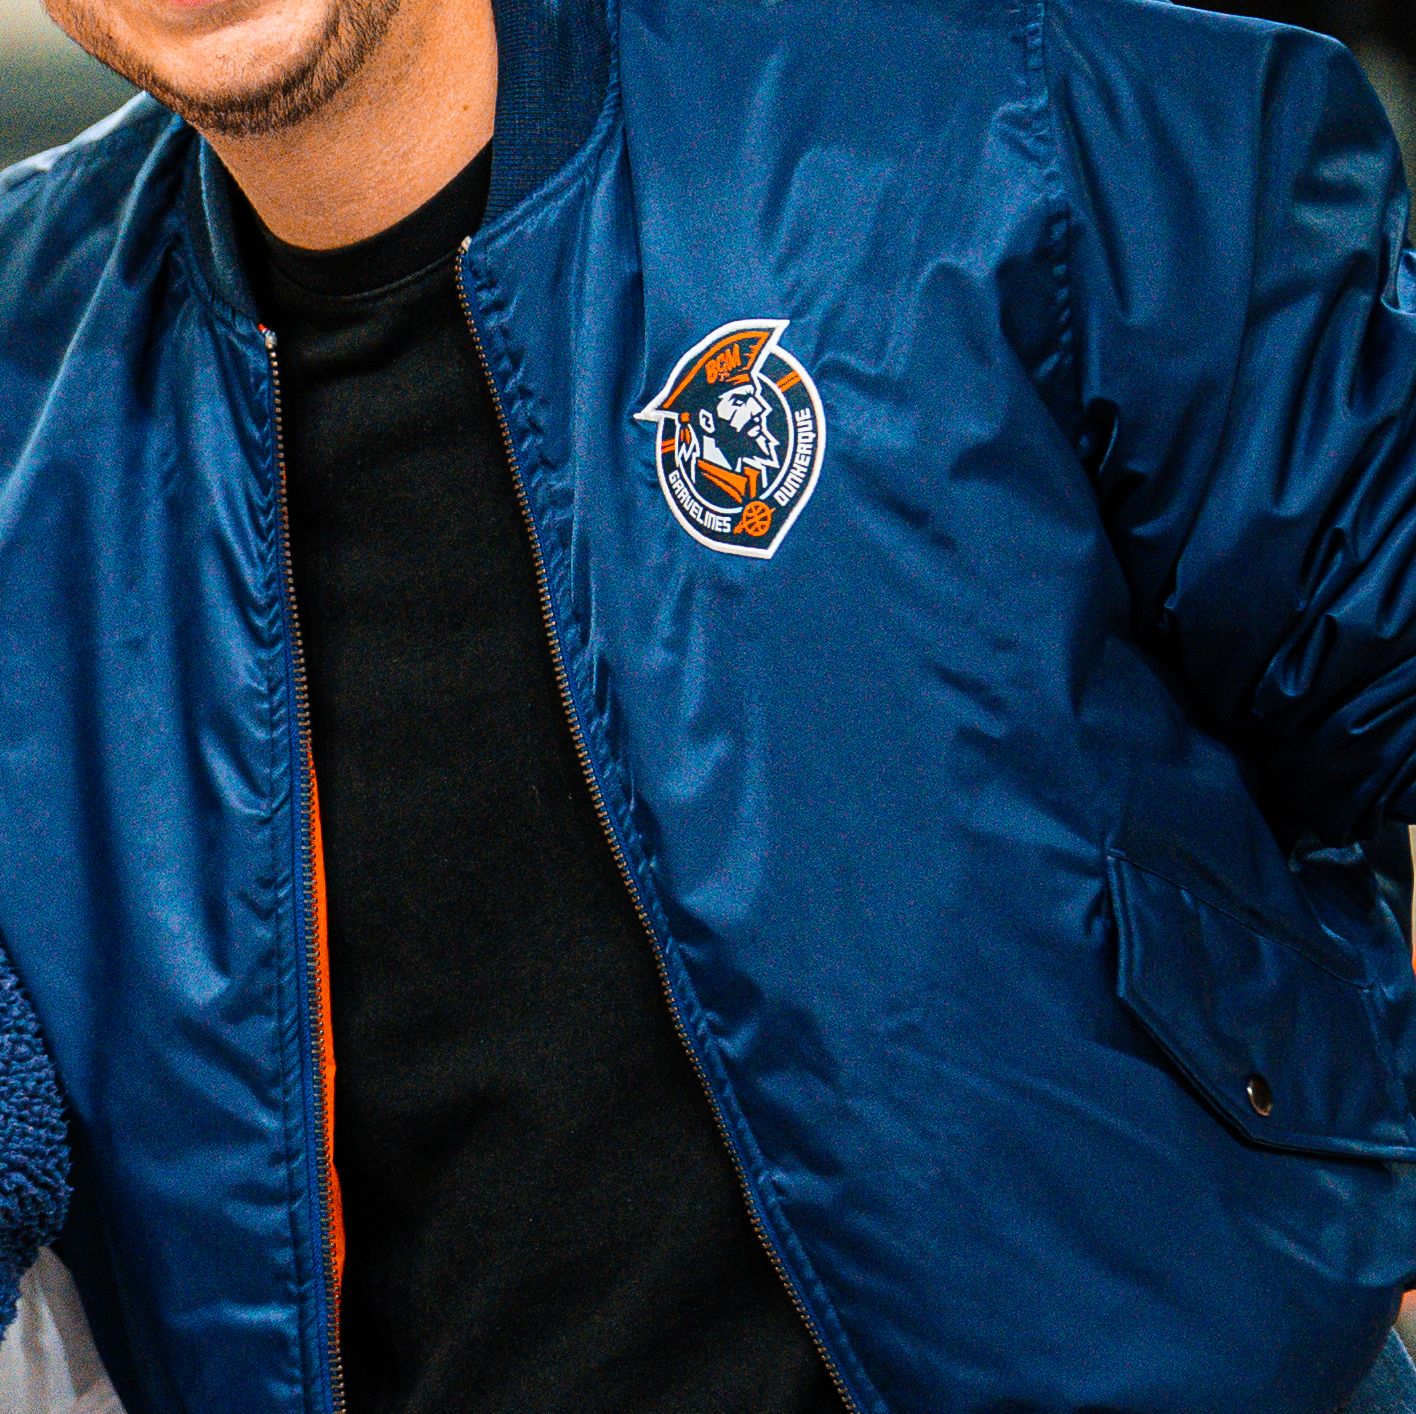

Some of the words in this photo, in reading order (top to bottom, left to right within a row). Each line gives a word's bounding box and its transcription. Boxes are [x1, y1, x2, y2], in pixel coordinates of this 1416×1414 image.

[705, 344, 742, 384] BCM
[668, 469, 732, 533] GRAVELINES
[773, 407, 817, 507] DUNKERQUE
